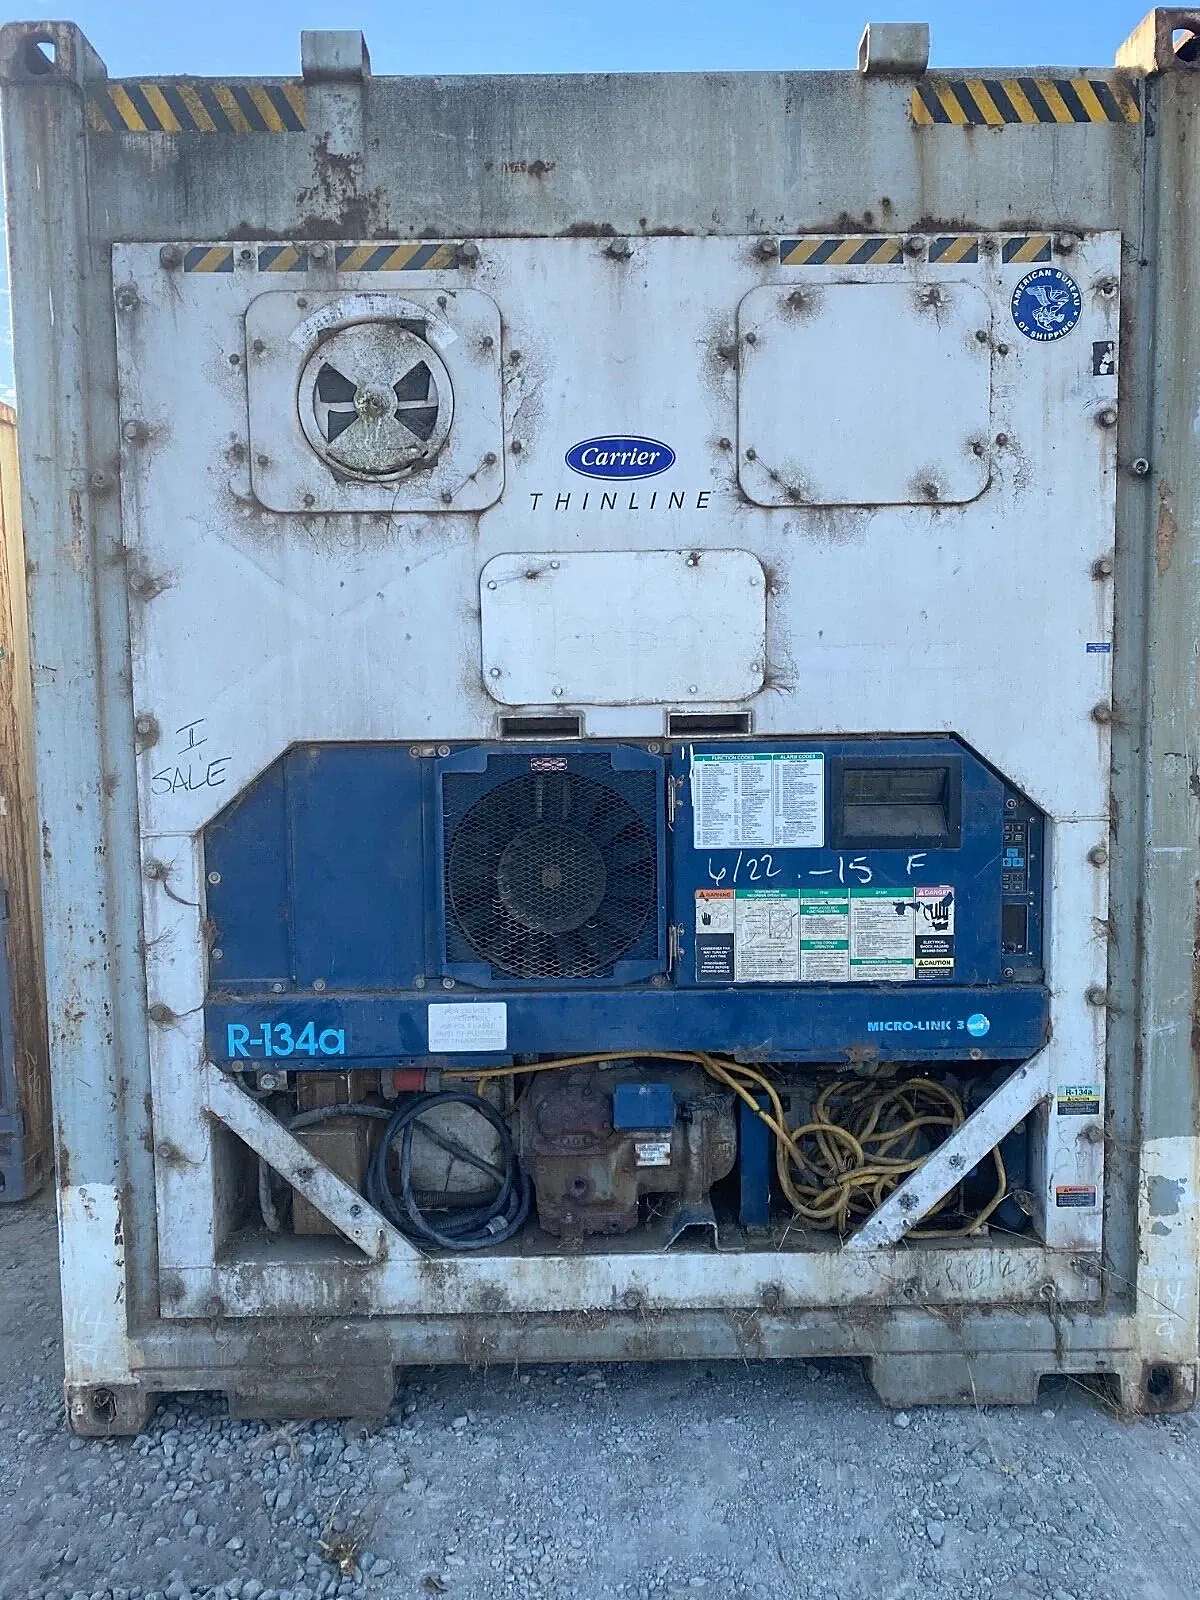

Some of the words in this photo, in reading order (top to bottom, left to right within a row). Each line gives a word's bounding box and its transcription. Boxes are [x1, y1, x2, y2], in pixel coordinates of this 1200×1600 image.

[1013, 269, 1052, 306] AMERICAN
[1055, 271, 1080, 306] BUREAU
[1018, 321, 1030, 333] OF
[1030, 320, 1075, 340] SHIPPING
[581, 447, 661, 466] Carrier
[530, 491, 712, 511] THINLINE
[151, 756, 232, 795] SALE
[906, 852, 928, 875] F
[867, 1021, 952, 1031] MICRO-LINK
[956, 1021, 965, 1030] 3
[227, 1022, 345, 1057] R-134a
